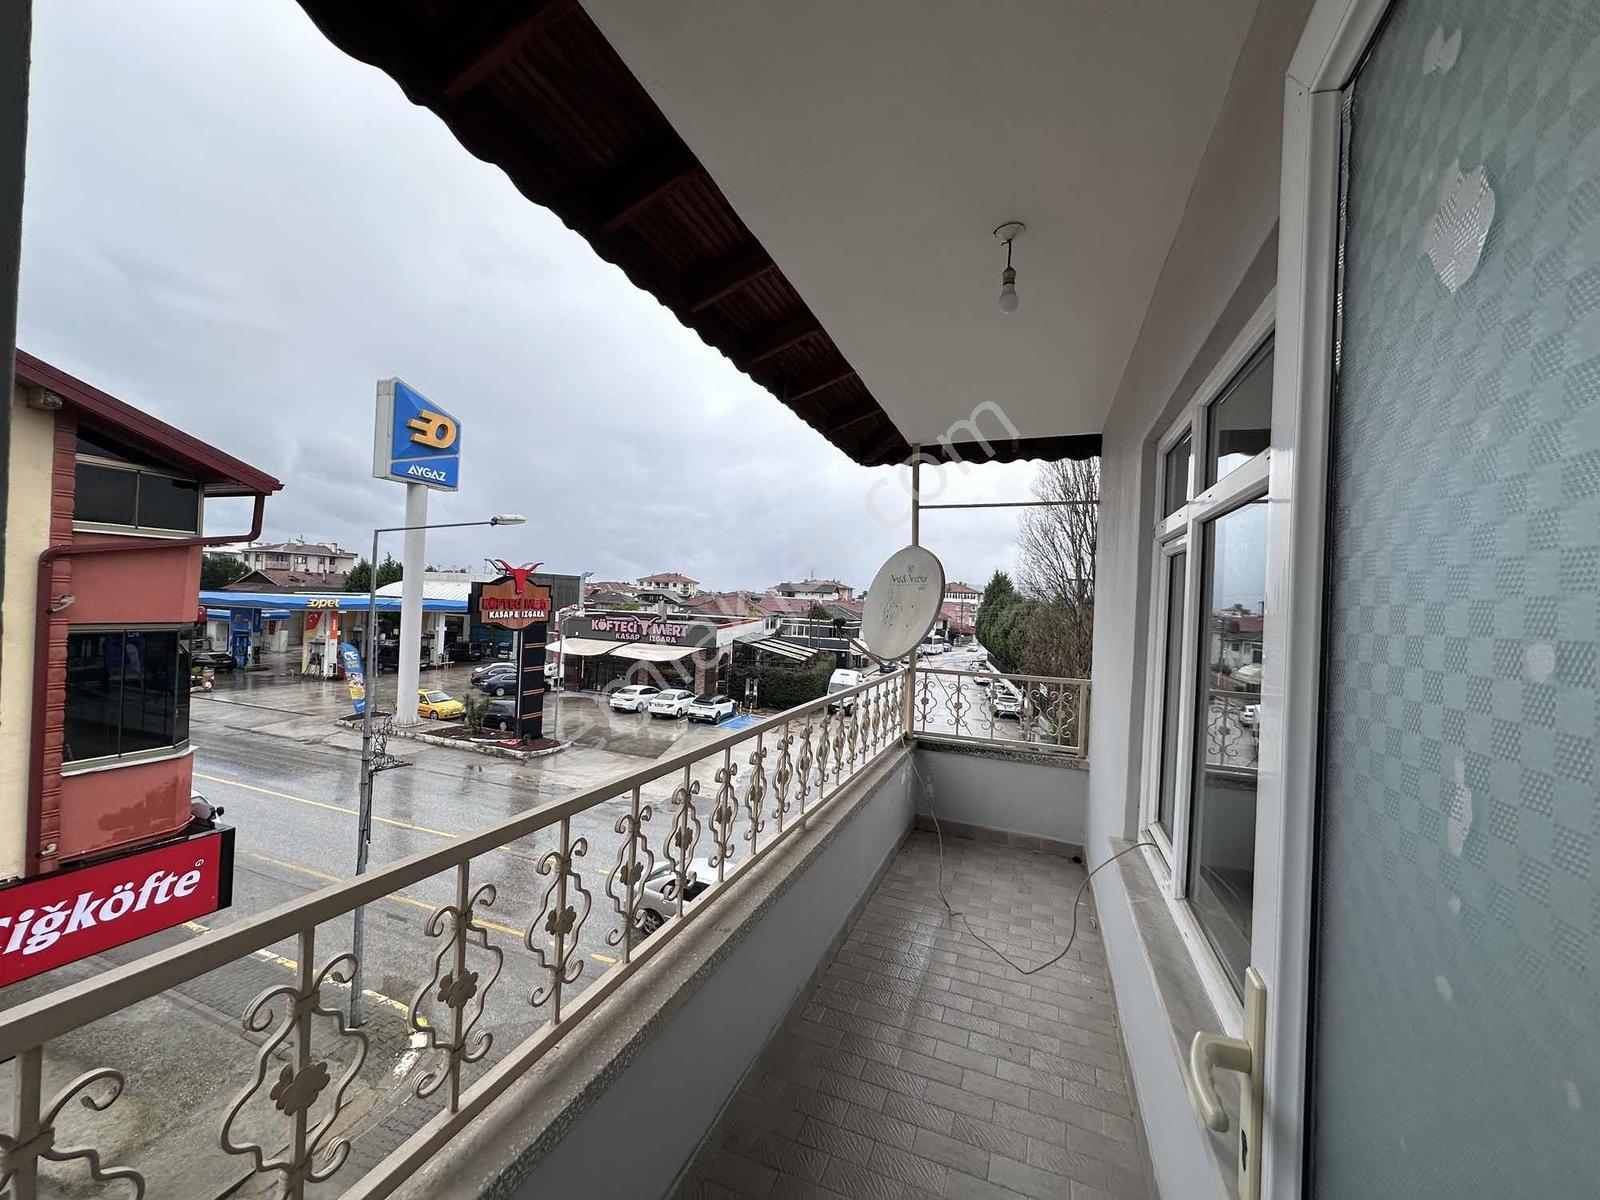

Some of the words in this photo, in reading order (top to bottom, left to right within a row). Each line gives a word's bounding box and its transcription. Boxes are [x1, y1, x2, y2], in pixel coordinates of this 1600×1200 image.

[408, 464, 446, 481] AYGAZ
[308, 598, 340, 608] opet
[524, 598, 548, 610] MERT
[652, 622, 688, 637] MERT
[0, 870, 201, 955] iğköfte
